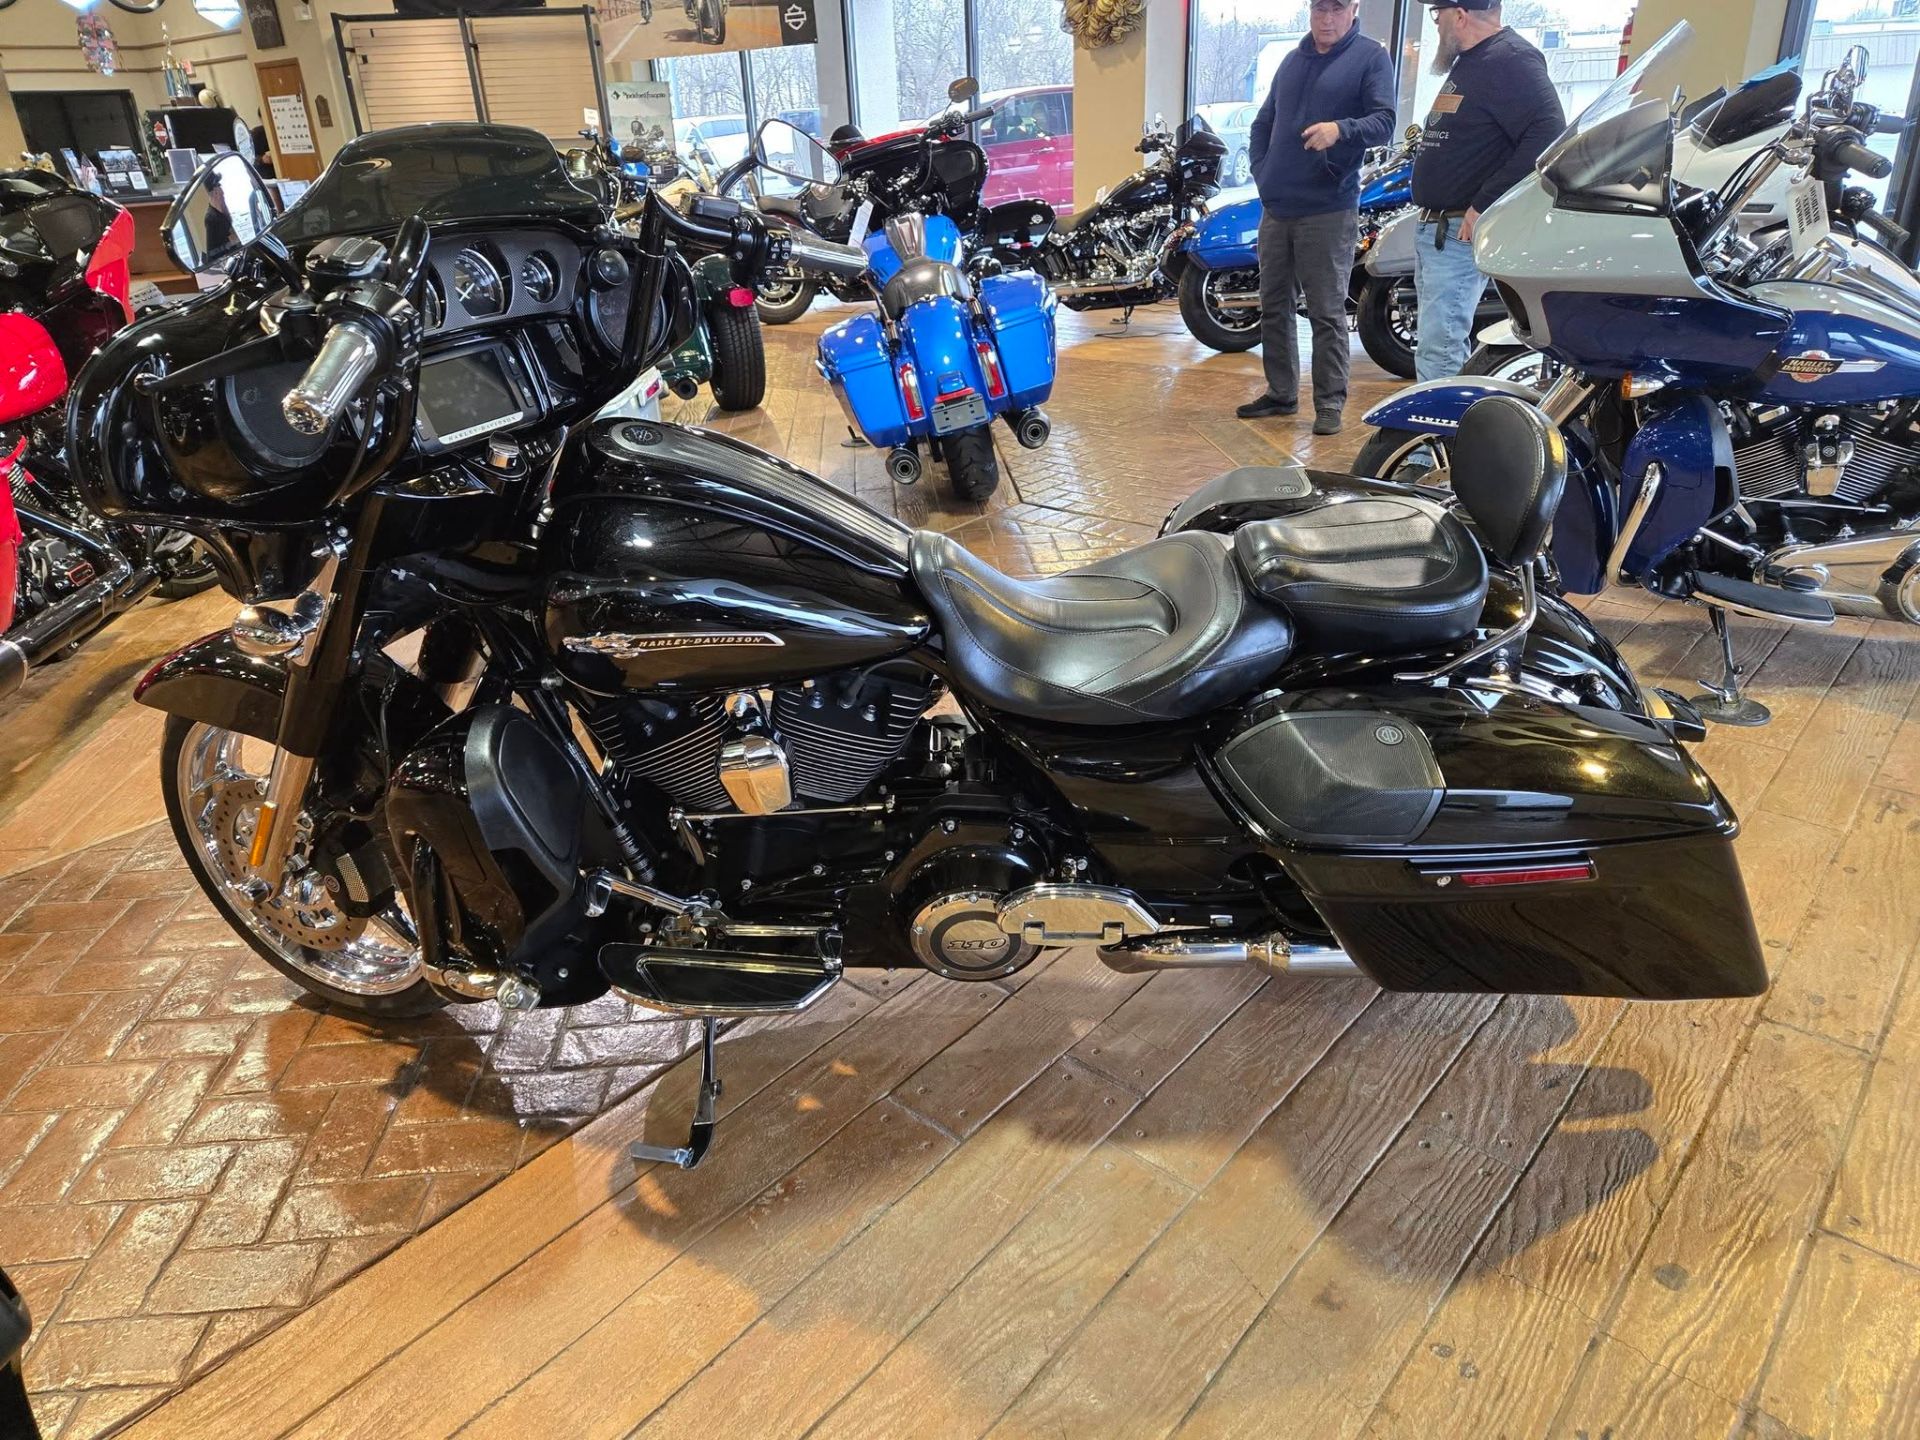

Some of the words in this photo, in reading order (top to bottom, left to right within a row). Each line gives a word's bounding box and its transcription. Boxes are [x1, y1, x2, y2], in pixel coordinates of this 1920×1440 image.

[1809, 184, 1820, 223] DAVIDSON
[1781, 365, 1833, 373] DAVIDSON
[1408, 415, 1459, 427] LIMITE
[448, 416, 516, 441] HARLEY-DAVIDSON
[638, 636, 761, 647] HARLEY-DAVIDSON
